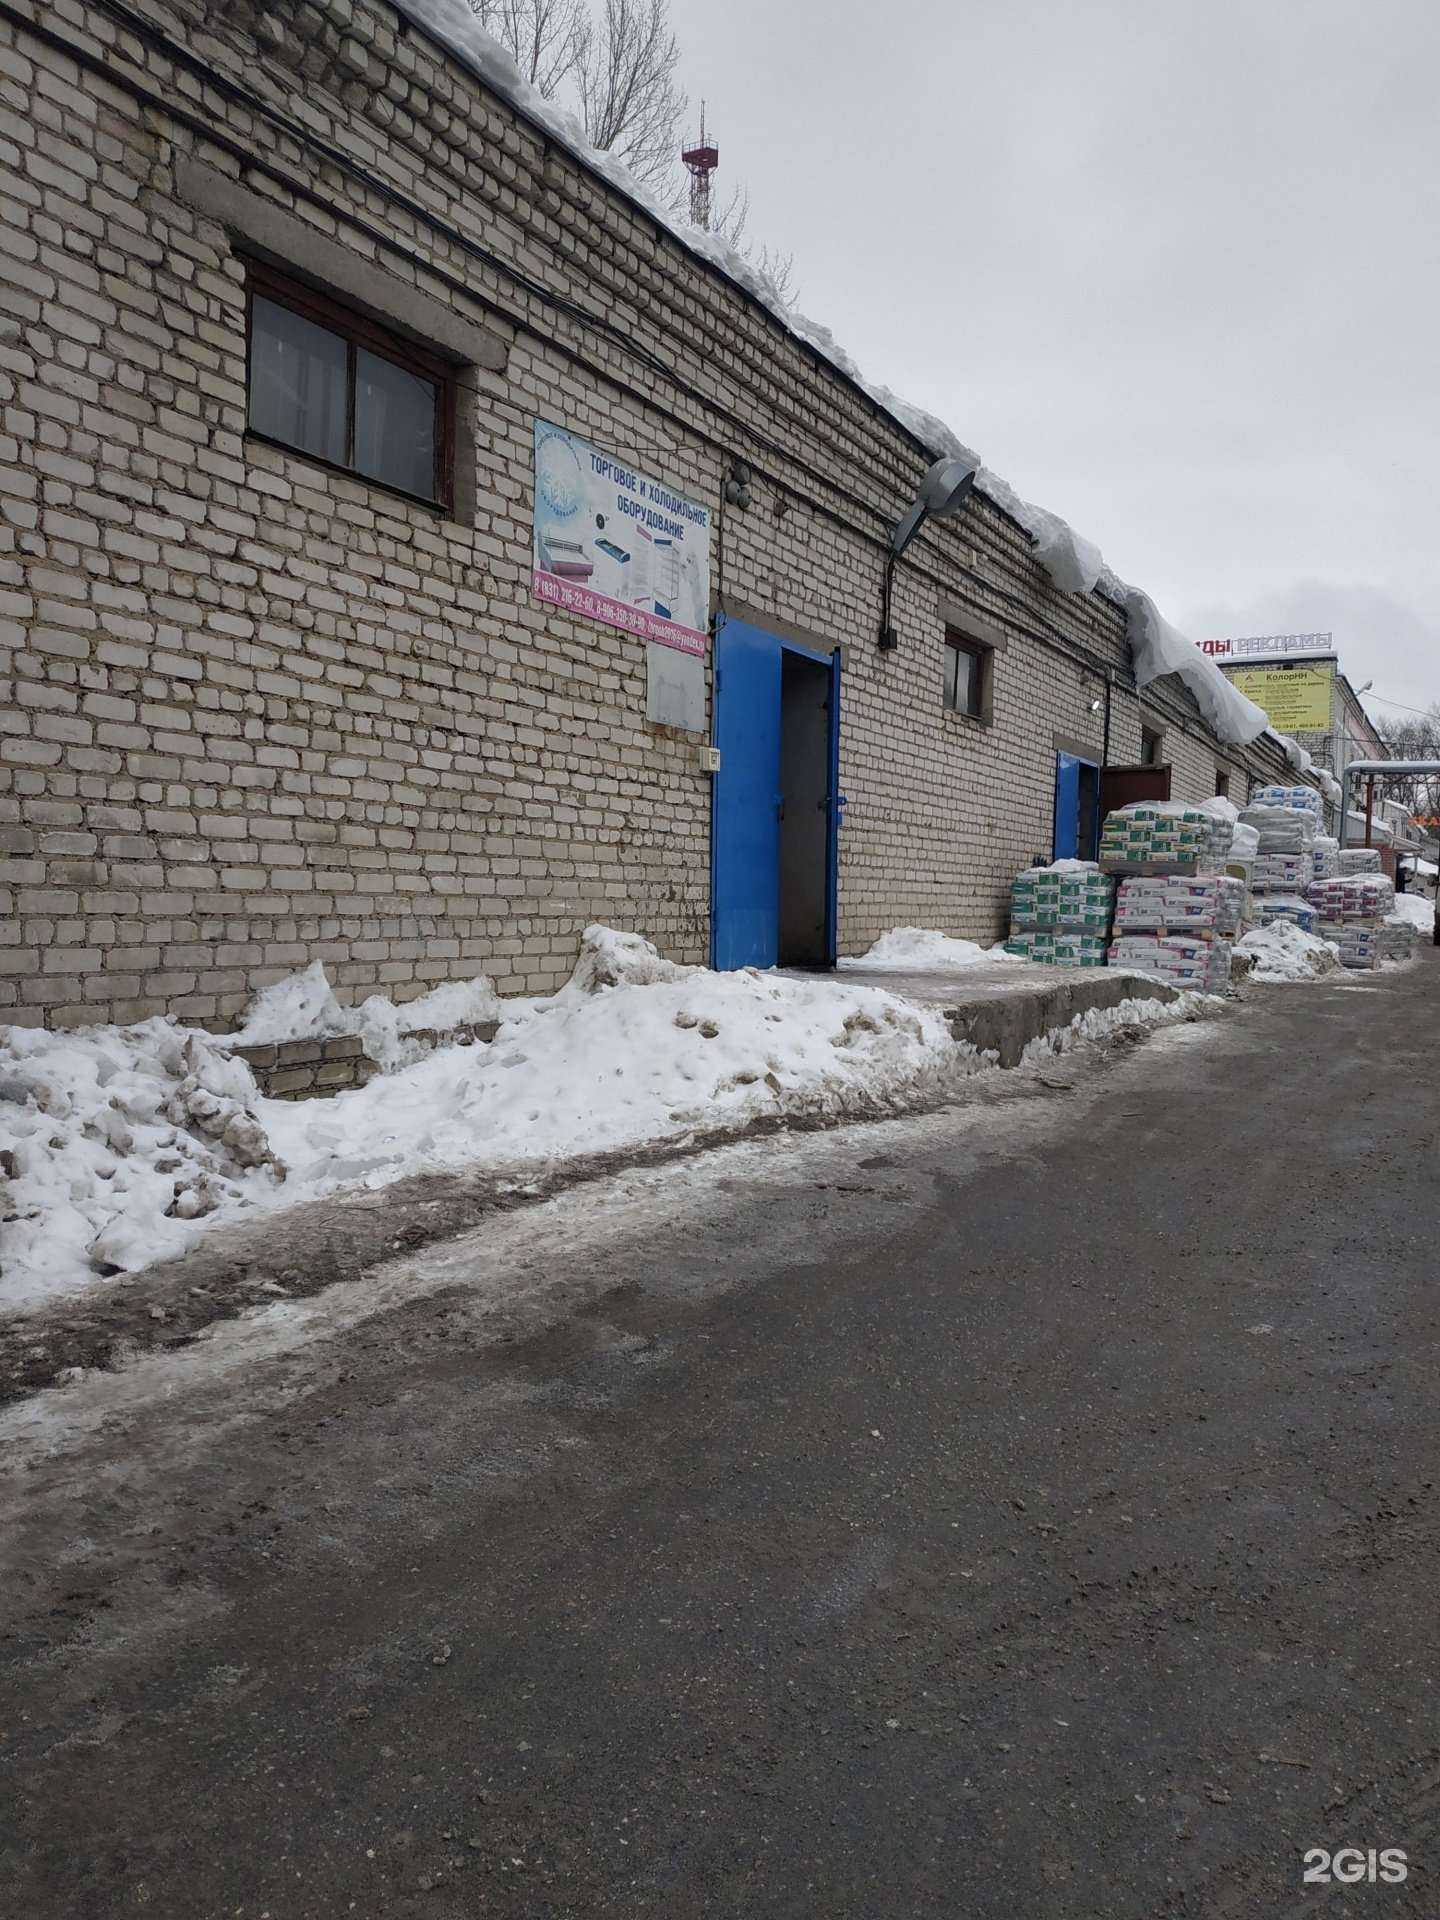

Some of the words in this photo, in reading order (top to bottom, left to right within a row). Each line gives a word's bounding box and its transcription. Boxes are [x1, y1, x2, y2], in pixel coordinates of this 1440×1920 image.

[590, 453, 637, 492] ТОРГОВОЕ
[640, 480, 646, 496] И
[649, 484, 707, 527] ХОЛОДИЛЬНОЕ
[617, 494, 684, 540] ОБОРУДОВАНИЕ
